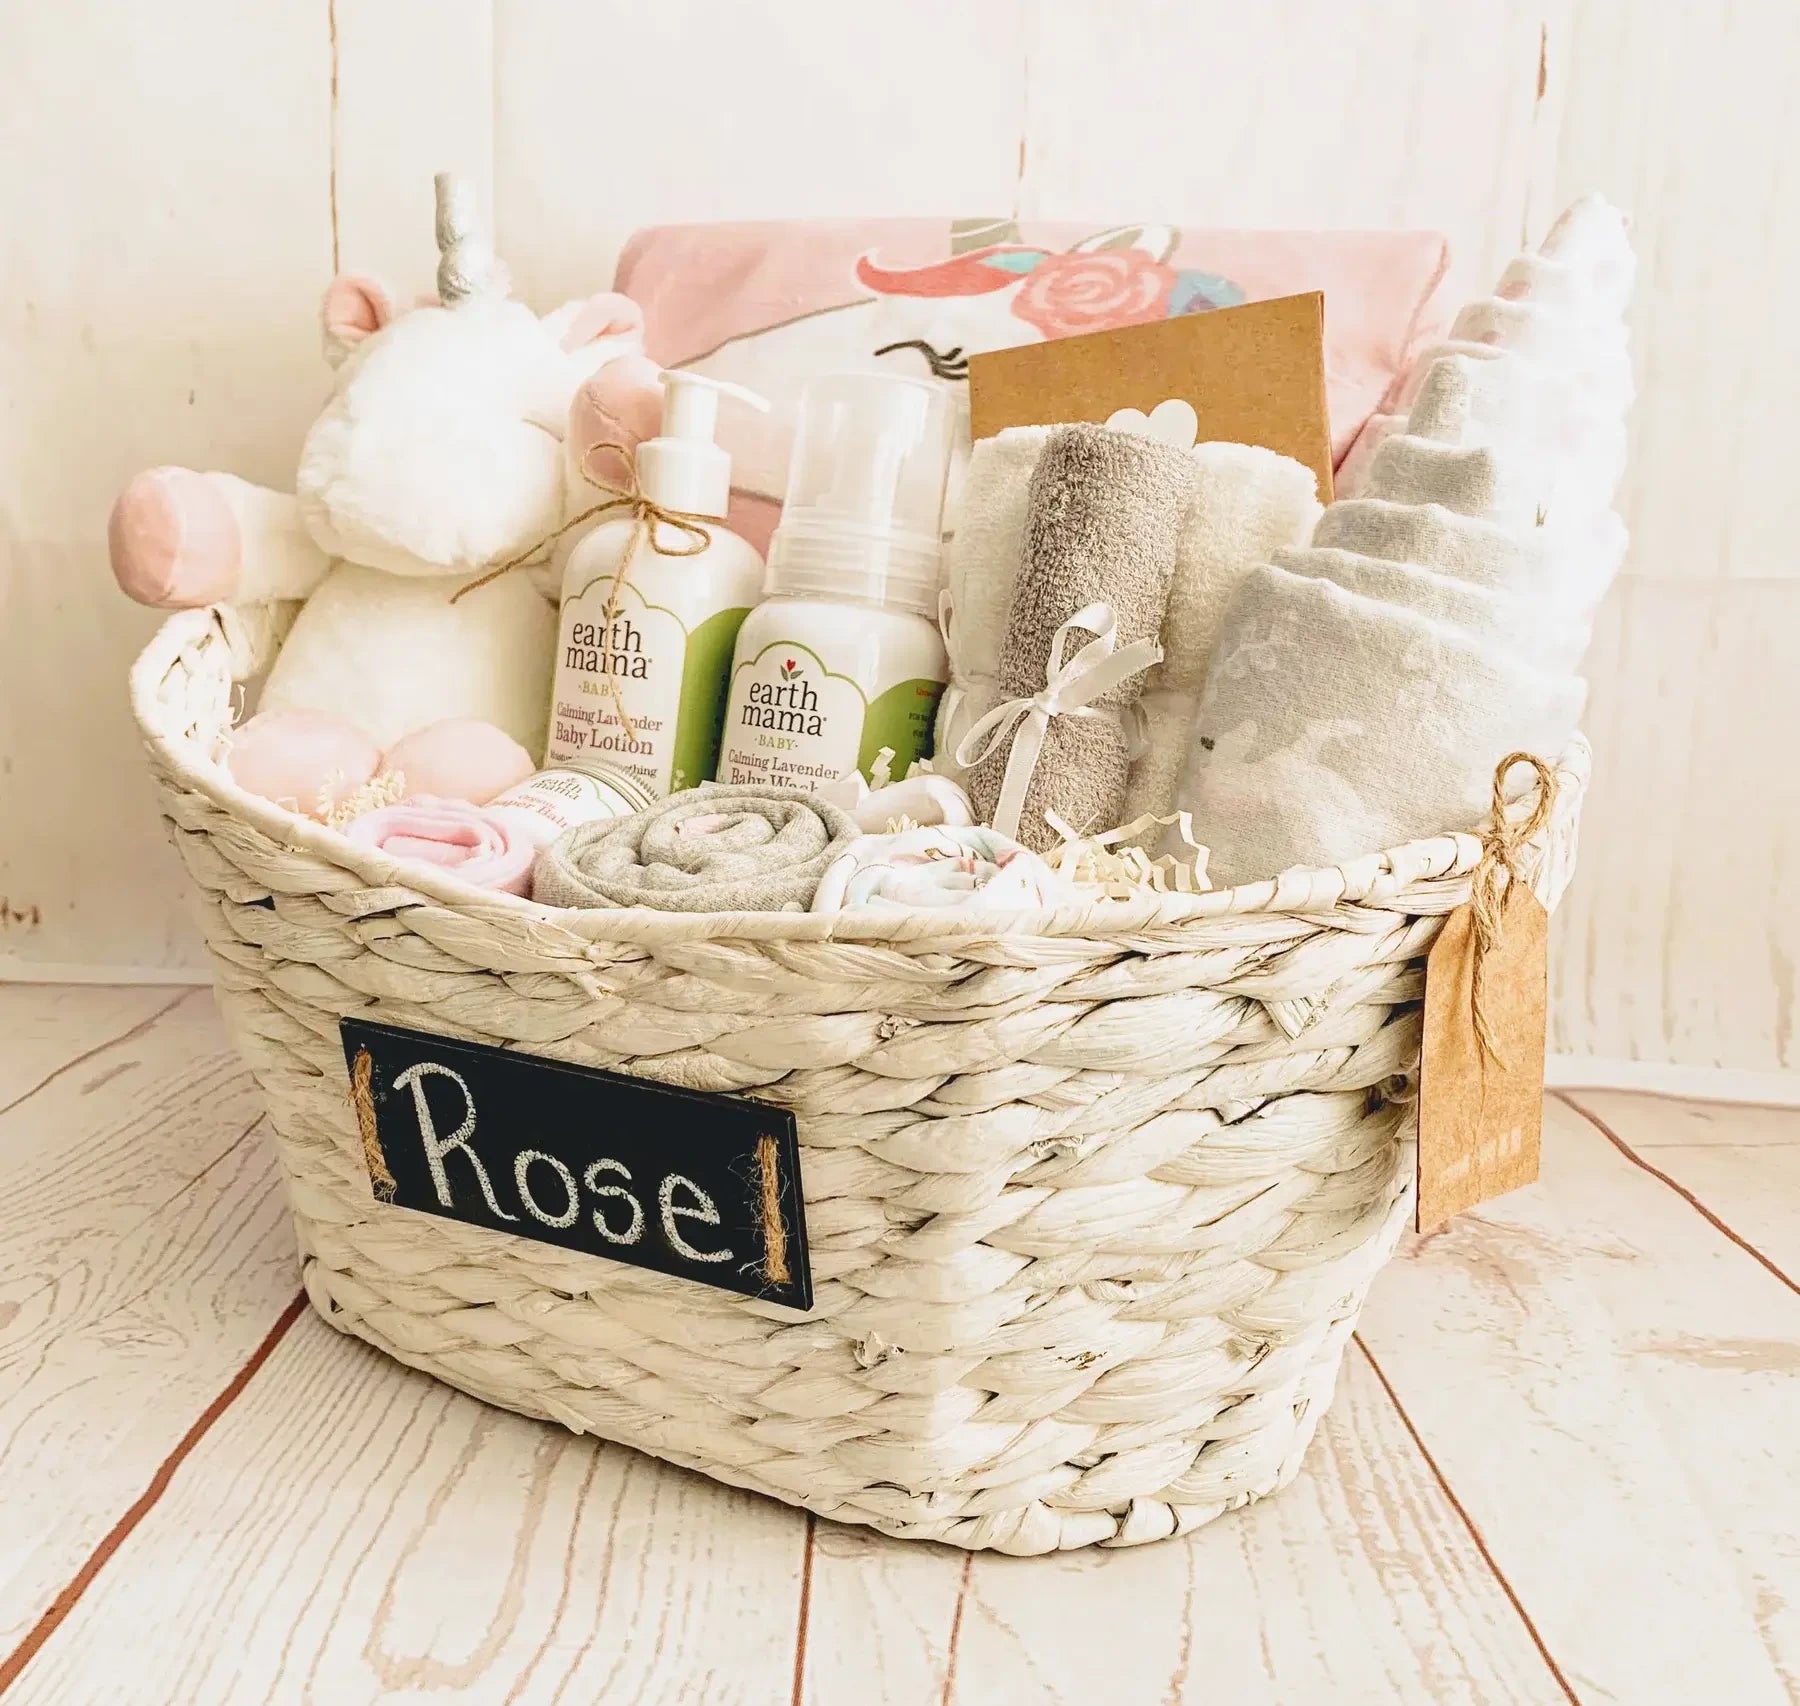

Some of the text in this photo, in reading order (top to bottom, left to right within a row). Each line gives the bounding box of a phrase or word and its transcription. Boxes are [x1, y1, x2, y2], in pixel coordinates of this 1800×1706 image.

[572, 620, 642, 652] earth
[749, 680, 818, 711] earth
[557, 701, 663, 731] Calming Lavnder
[741, 704, 823, 737] mama
[555, 721, 654, 755] Baby Lotion
[728, 748, 839, 780] Calming Lavender
[393, 1062, 735, 1263] Rose
